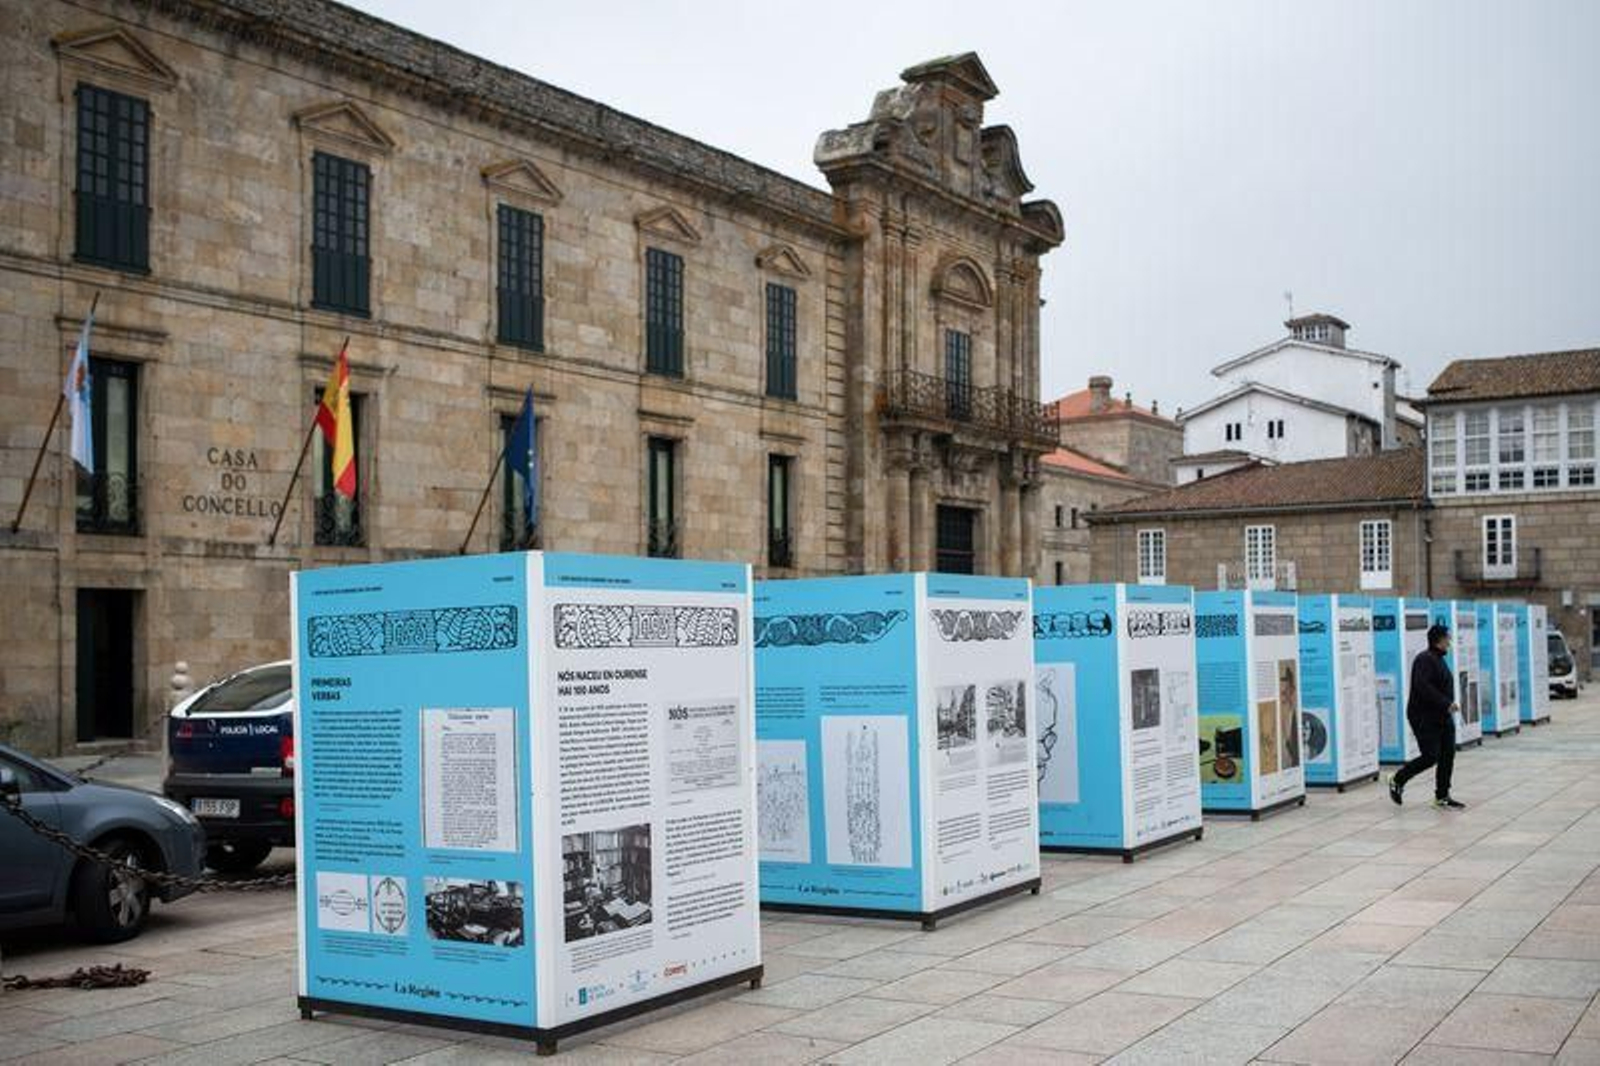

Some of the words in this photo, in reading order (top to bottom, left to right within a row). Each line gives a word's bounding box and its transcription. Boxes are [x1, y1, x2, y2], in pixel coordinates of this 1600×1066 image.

[207, 447, 258, 468] CASA
[221, 473, 246, 491] DO
[182, 495, 281, 518] CONCELLO
[576, 669, 602, 681] NACEU
[615, 668, 647, 680] OURENSE
[254, 724, 279, 734] LOCAL
